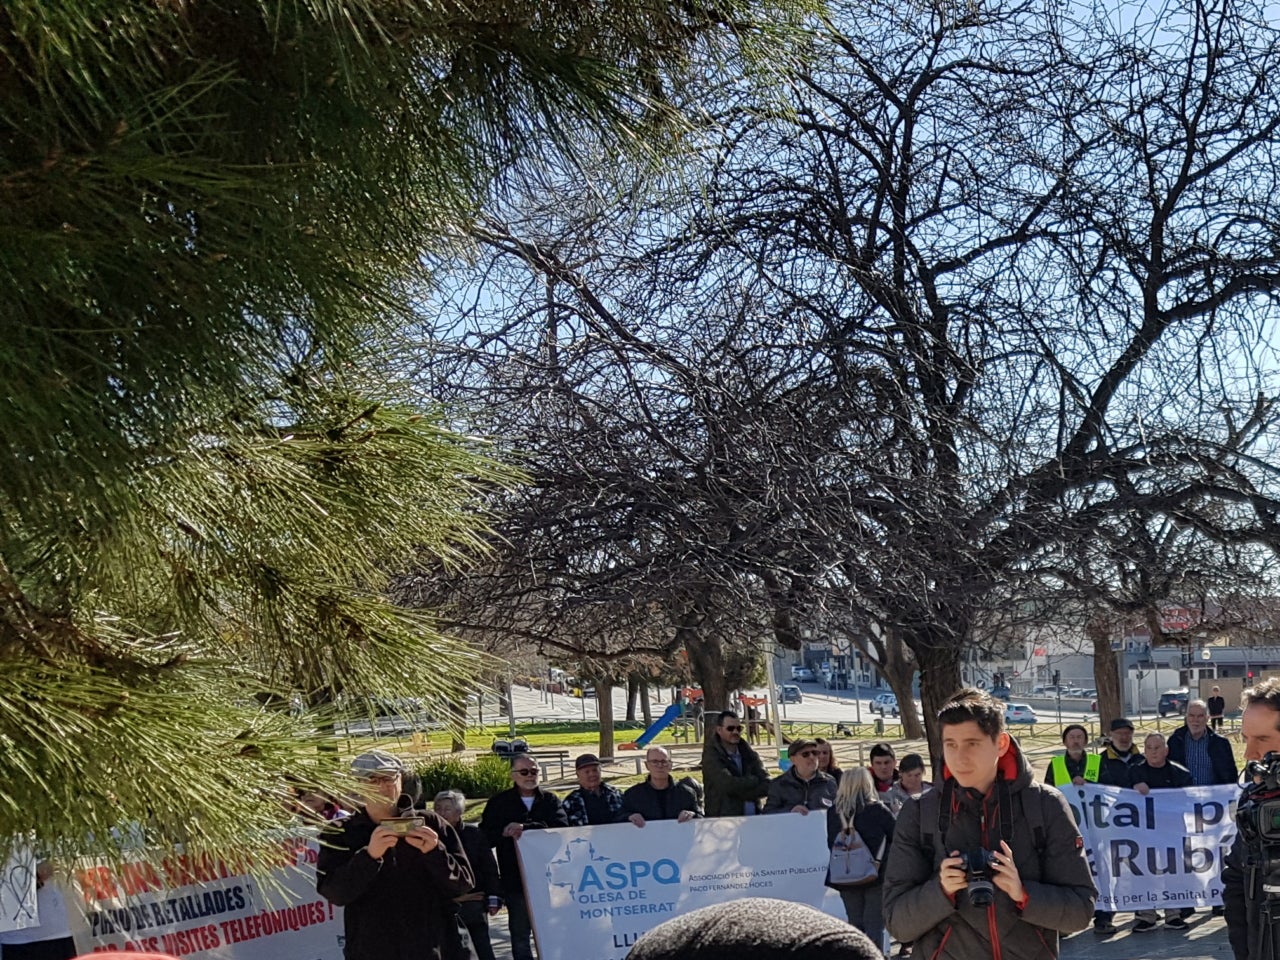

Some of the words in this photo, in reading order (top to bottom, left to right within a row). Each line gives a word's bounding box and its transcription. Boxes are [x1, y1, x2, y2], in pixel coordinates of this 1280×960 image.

[578, 891, 625, 905] OLESA
[628, 889, 648, 901] DE
[1122, 893, 1144, 906] per
[1147, 890, 1158, 902] la
[1162, 889, 1207, 901] Sanitat
[580, 901, 676, 920] MONTSERRAT
[161, 923, 221, 957] VISITES
[219, 900, 326, 946] TELEFÒNIQUES
